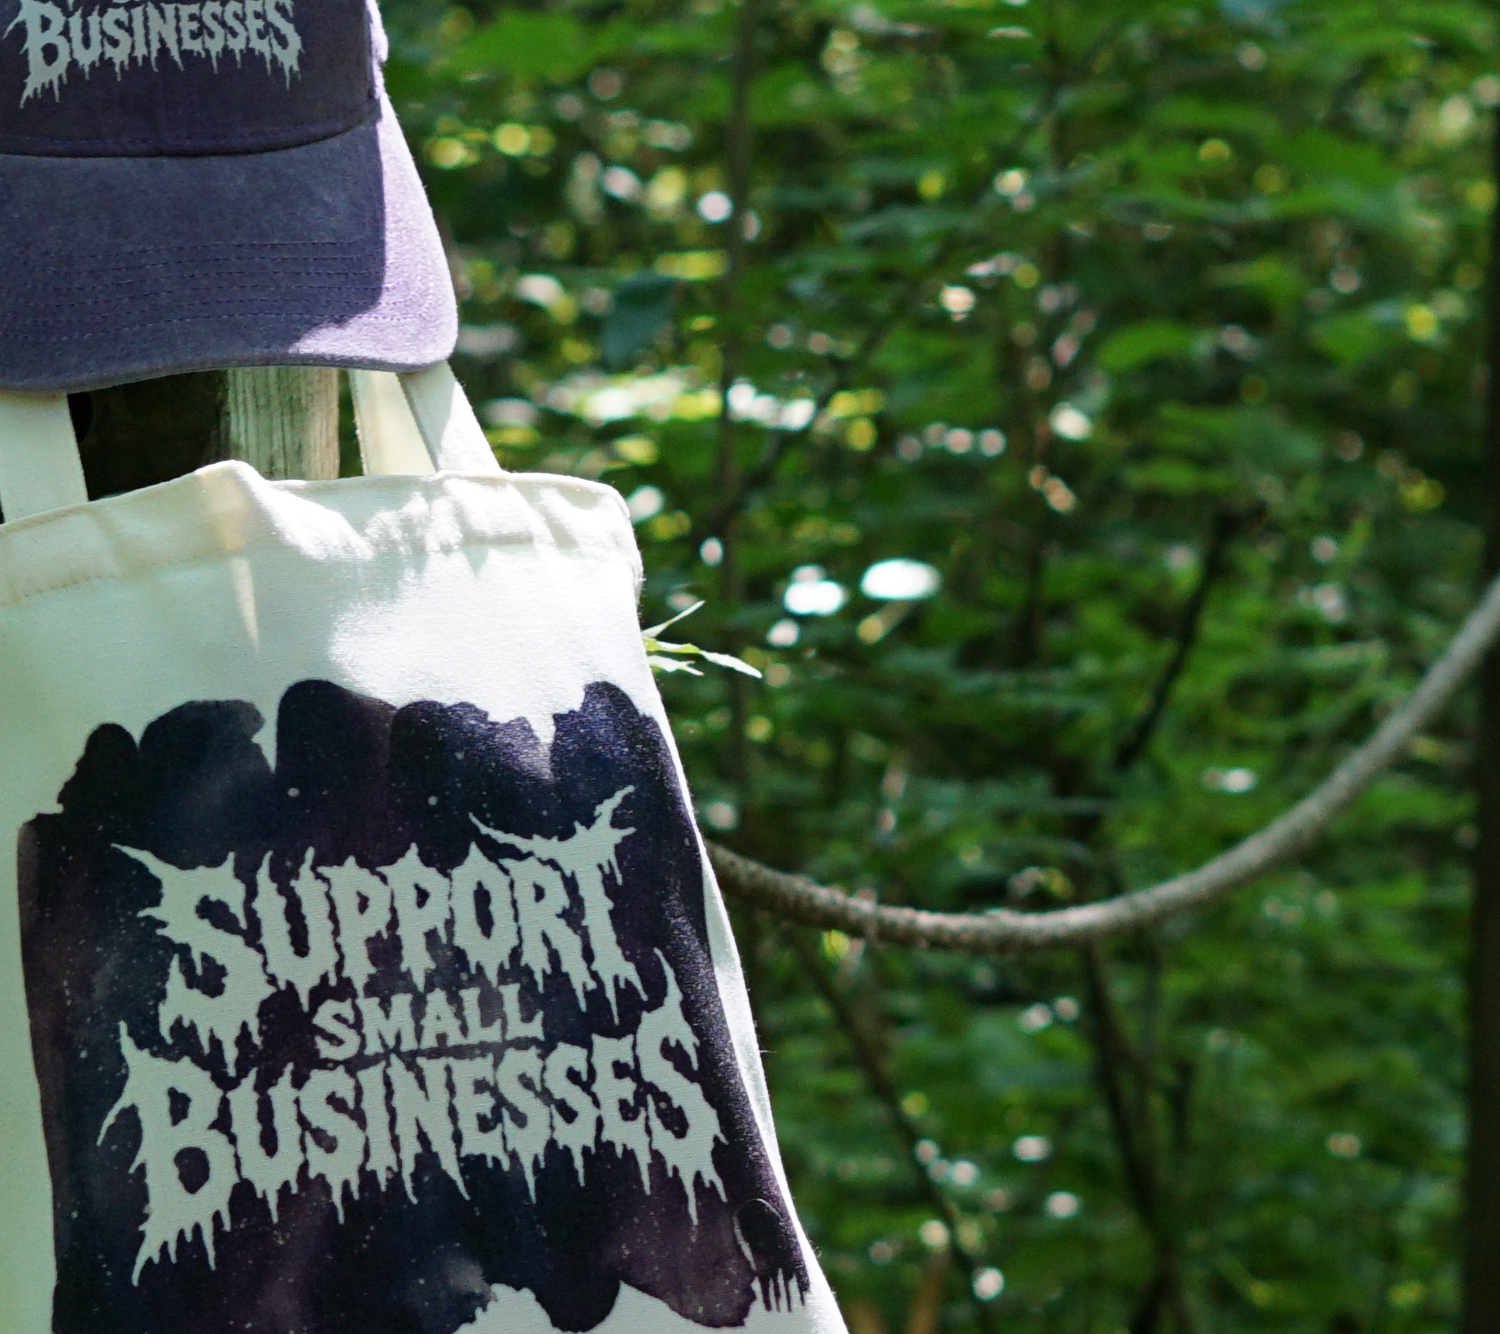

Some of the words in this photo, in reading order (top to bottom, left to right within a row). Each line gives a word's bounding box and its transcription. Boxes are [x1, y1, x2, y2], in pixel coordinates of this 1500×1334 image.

[112, 785, 637, 1073] SUPPORT
[313, 983, 543, 1062] SMALL
[97, 948, 727, 1286] BUSINESSES
